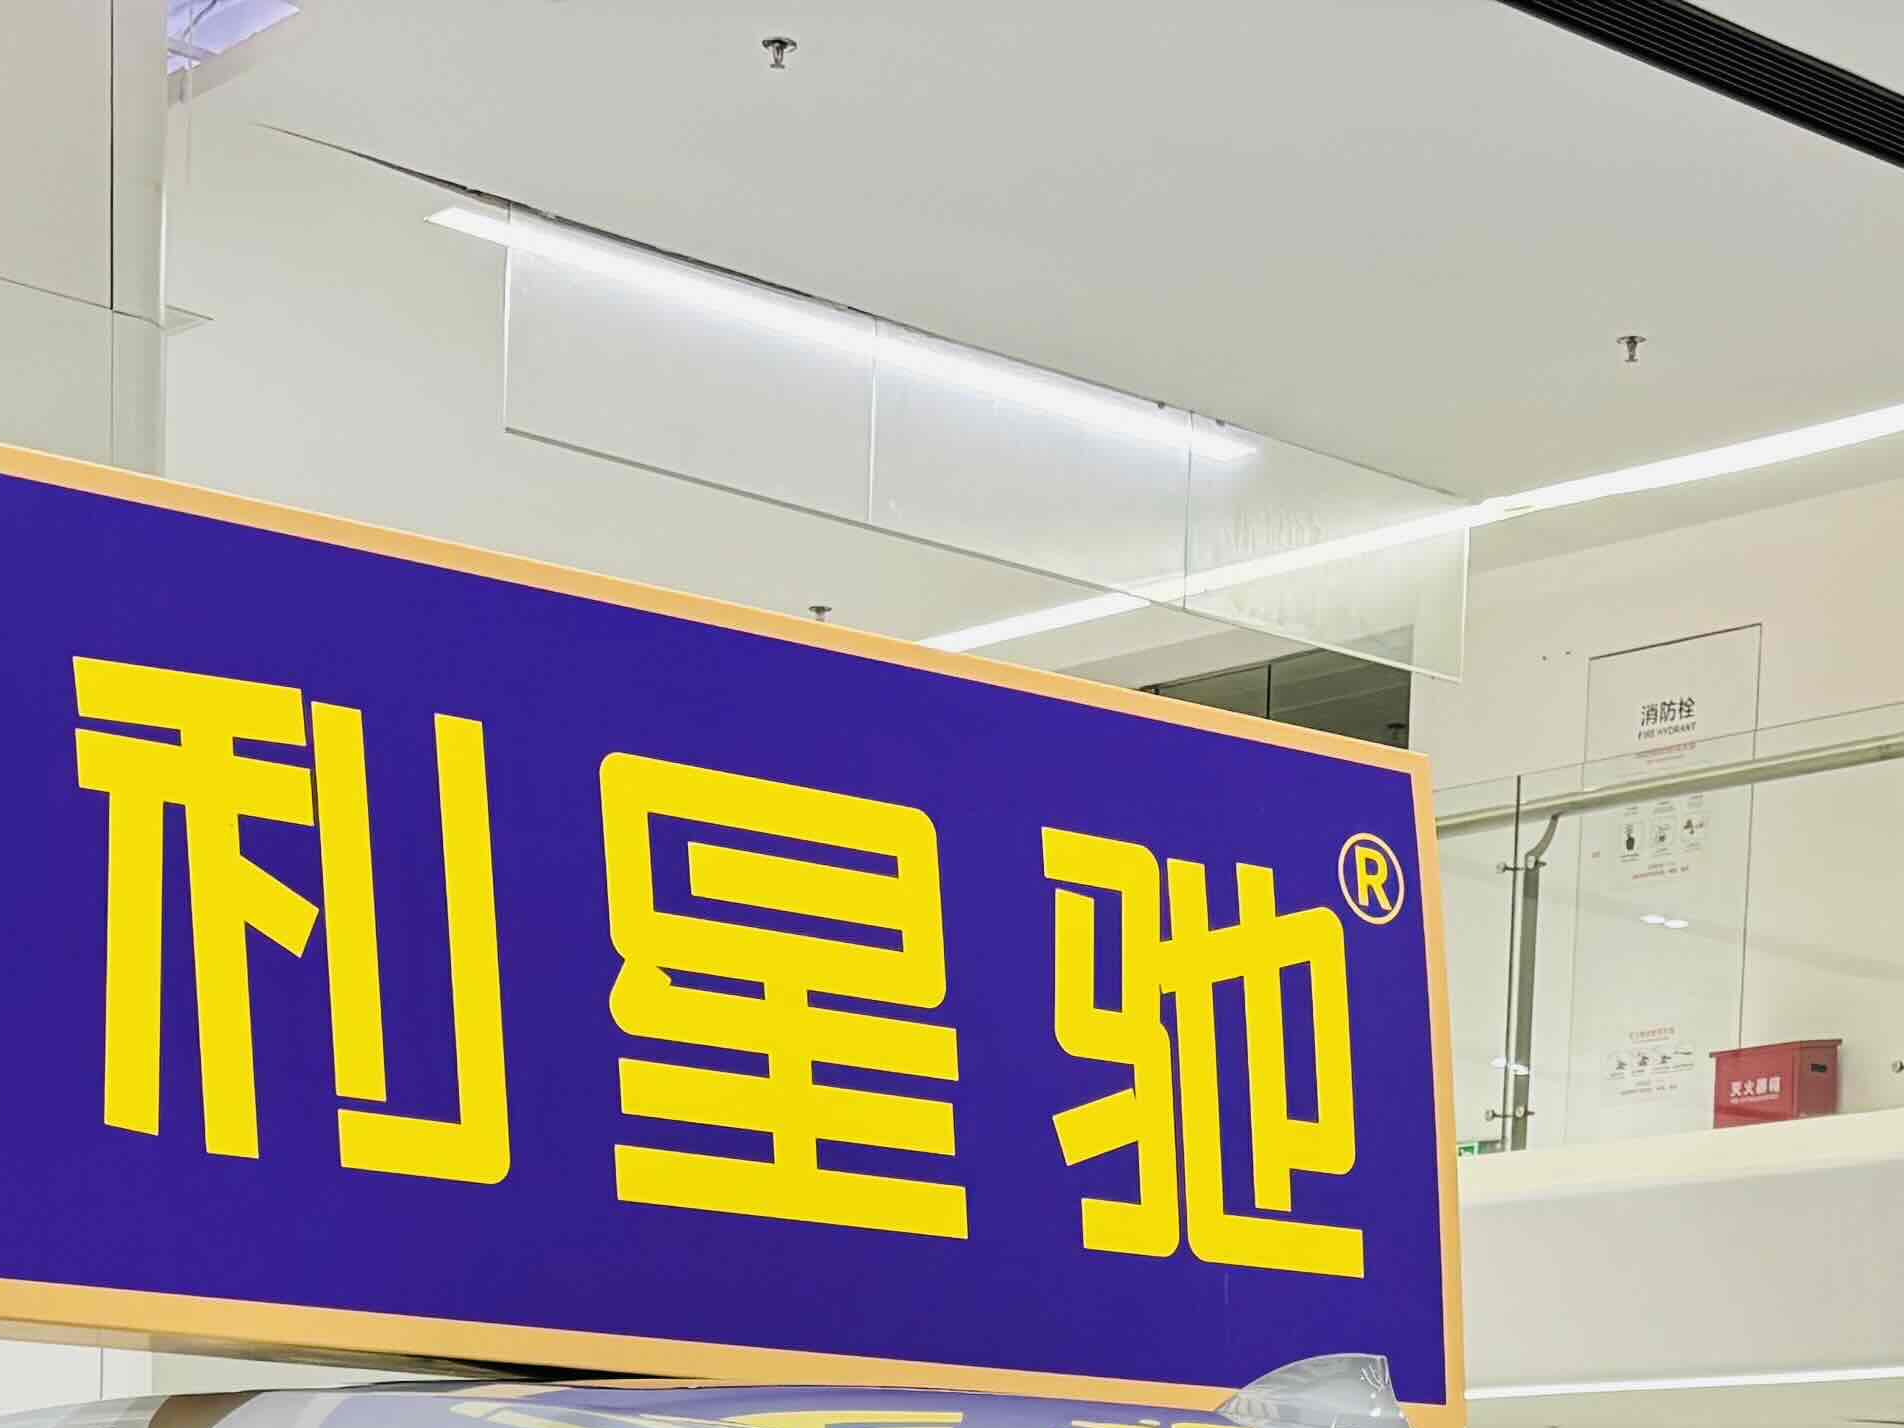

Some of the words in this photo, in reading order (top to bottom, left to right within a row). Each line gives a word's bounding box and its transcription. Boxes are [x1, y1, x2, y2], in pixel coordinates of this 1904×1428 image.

[1640, 697, 1696, 727] 消防栓
[71, 655, 1365, 1278] 利星驰
